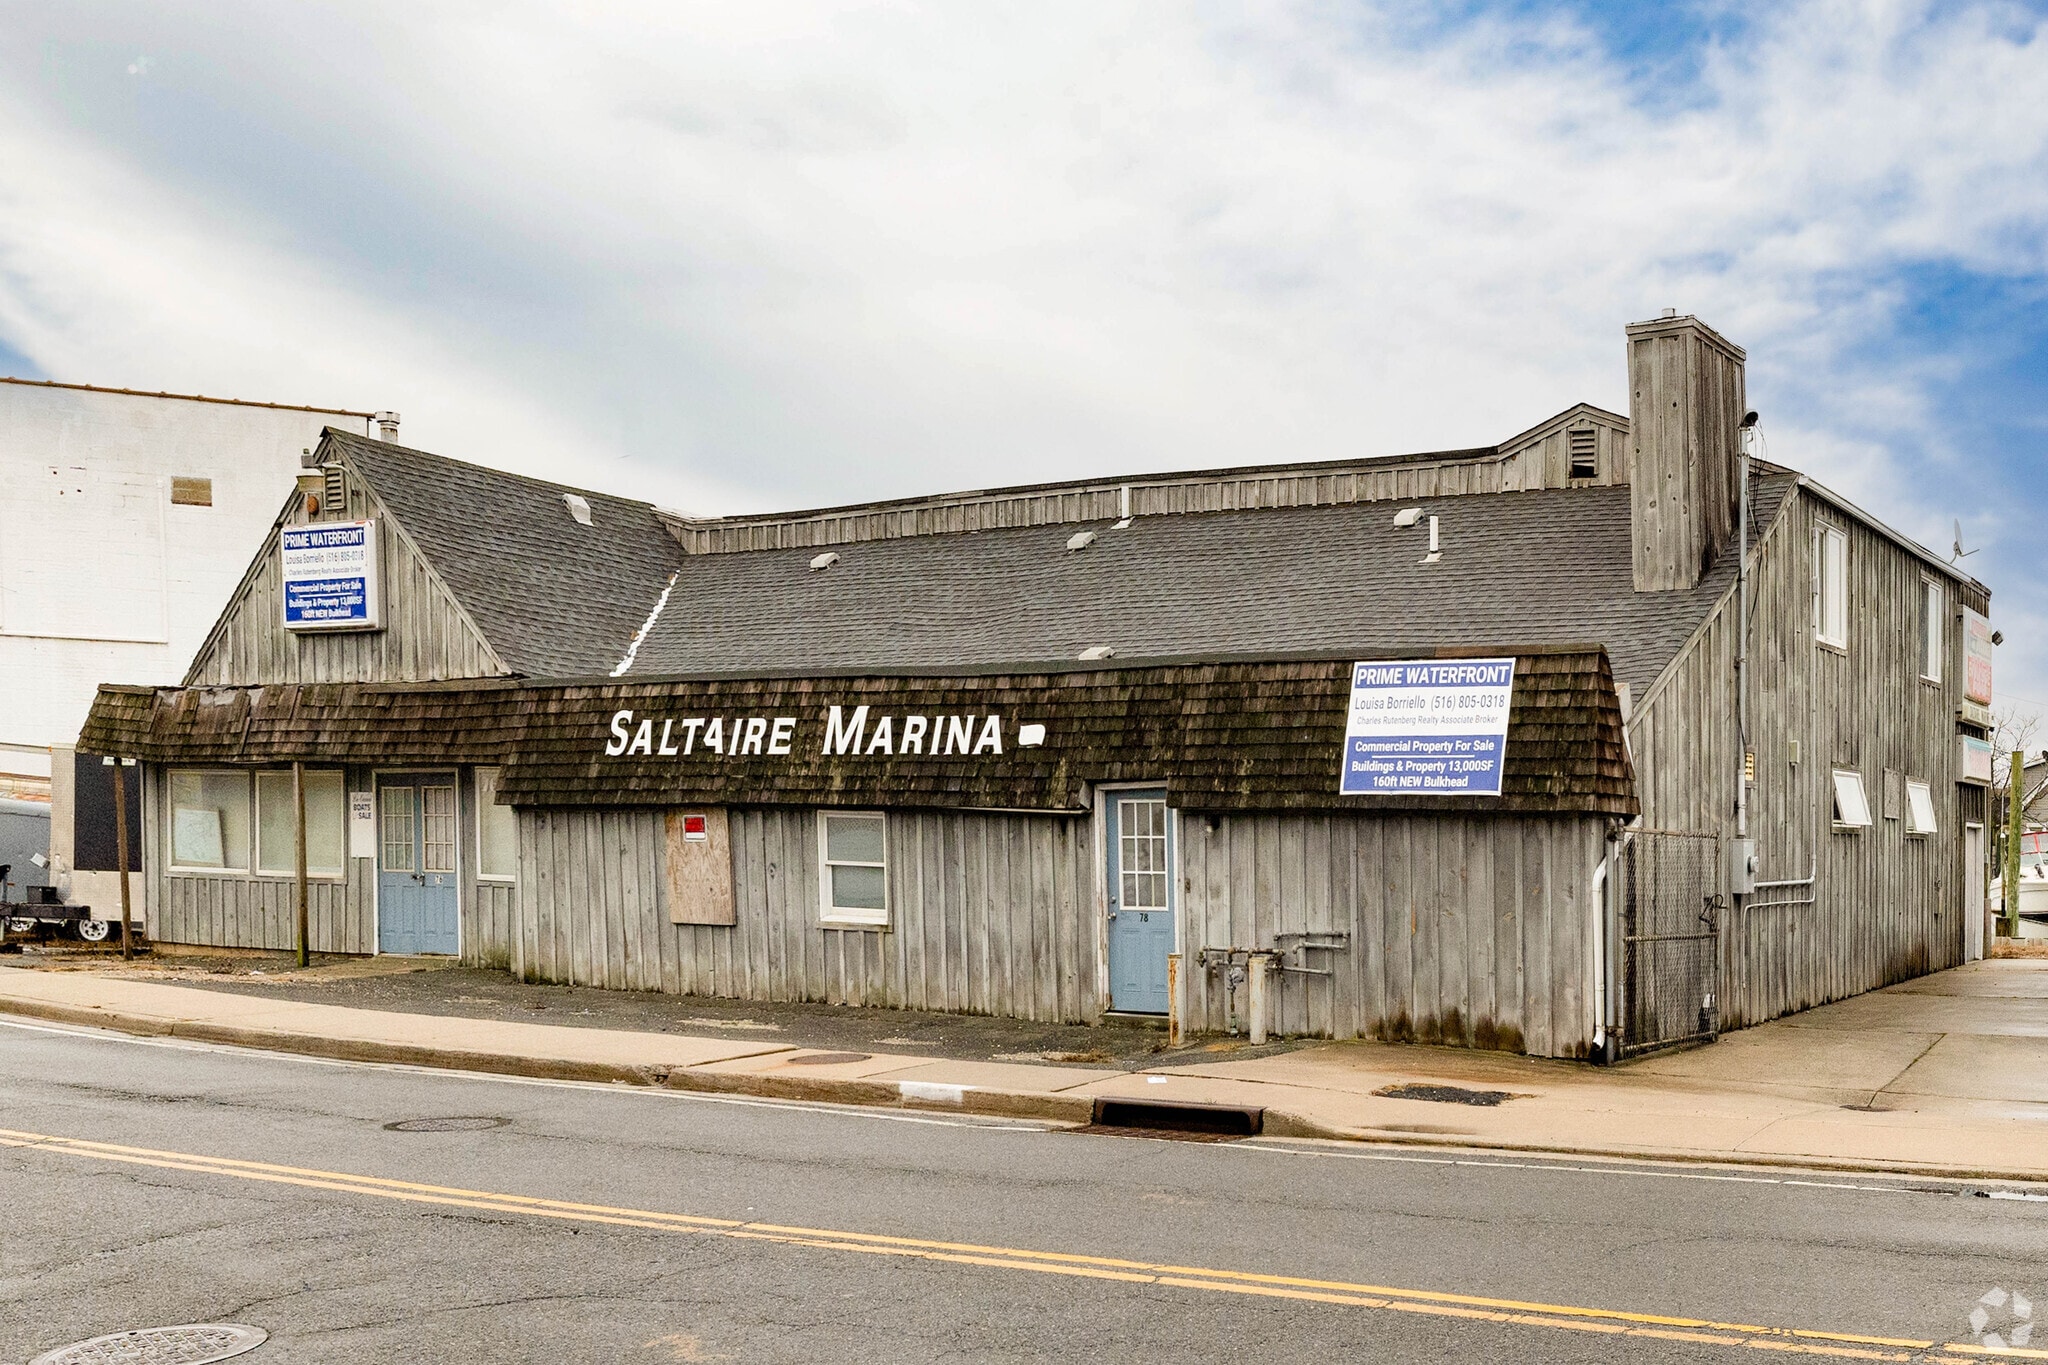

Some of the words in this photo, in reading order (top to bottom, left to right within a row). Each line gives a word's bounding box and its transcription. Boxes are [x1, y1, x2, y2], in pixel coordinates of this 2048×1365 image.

[285, 533, 309, 548] PRIME
[310, 530, 363, 546] WATERFRONT
[289, 583, 319, 593] Commercial
[320, 582, 341, 593] Property
[342, 581, 350, 590] For
[351, 580, 362, 590] Sale
[317, 598, 339, 608] Property
[1356, 667, 1403, 685] PRIME
[1406, 666, 1510, 684] WATERFRONT
[1354, 697, 1384, 710] Louisa
[1387, 696, 1426, 709] Borriello
[1430, 695, 1456, 712] (516)
[1459, 694, 1505, 709] 805-0318
[1357, 716, 1381, 725] Charles
[1383, 716, 1416, 726] Rutenberg
[1418, 716, 1438, 726] Realty
[1440, 715, 1474, 725] Associate
[1475, 715, 1498, 724] Broker
[821, 705, 1004, 756] MARINA
[1355, 740, 1411, 752] Commercial
[1412, 740, 1453, 754] Property
[1455, 740, 1471, 751] For
[1473, 740, 1495, 751] Sale
[1351, 761, 1394, 774] Buildings
[1396, 761, 1403, 772] &
[1405, 761, 1446, 774] Property
[1449, 760, 1494, 774] 13,000SF
[1373, 776, 1398, 787] 160ft
[1400, 776, 1423, 787] NEW
[1424, 776, 1469, 787] Bulkhead
[358, 812, 371, 820] SALE
[1140, 913, 1149, 922] 78
